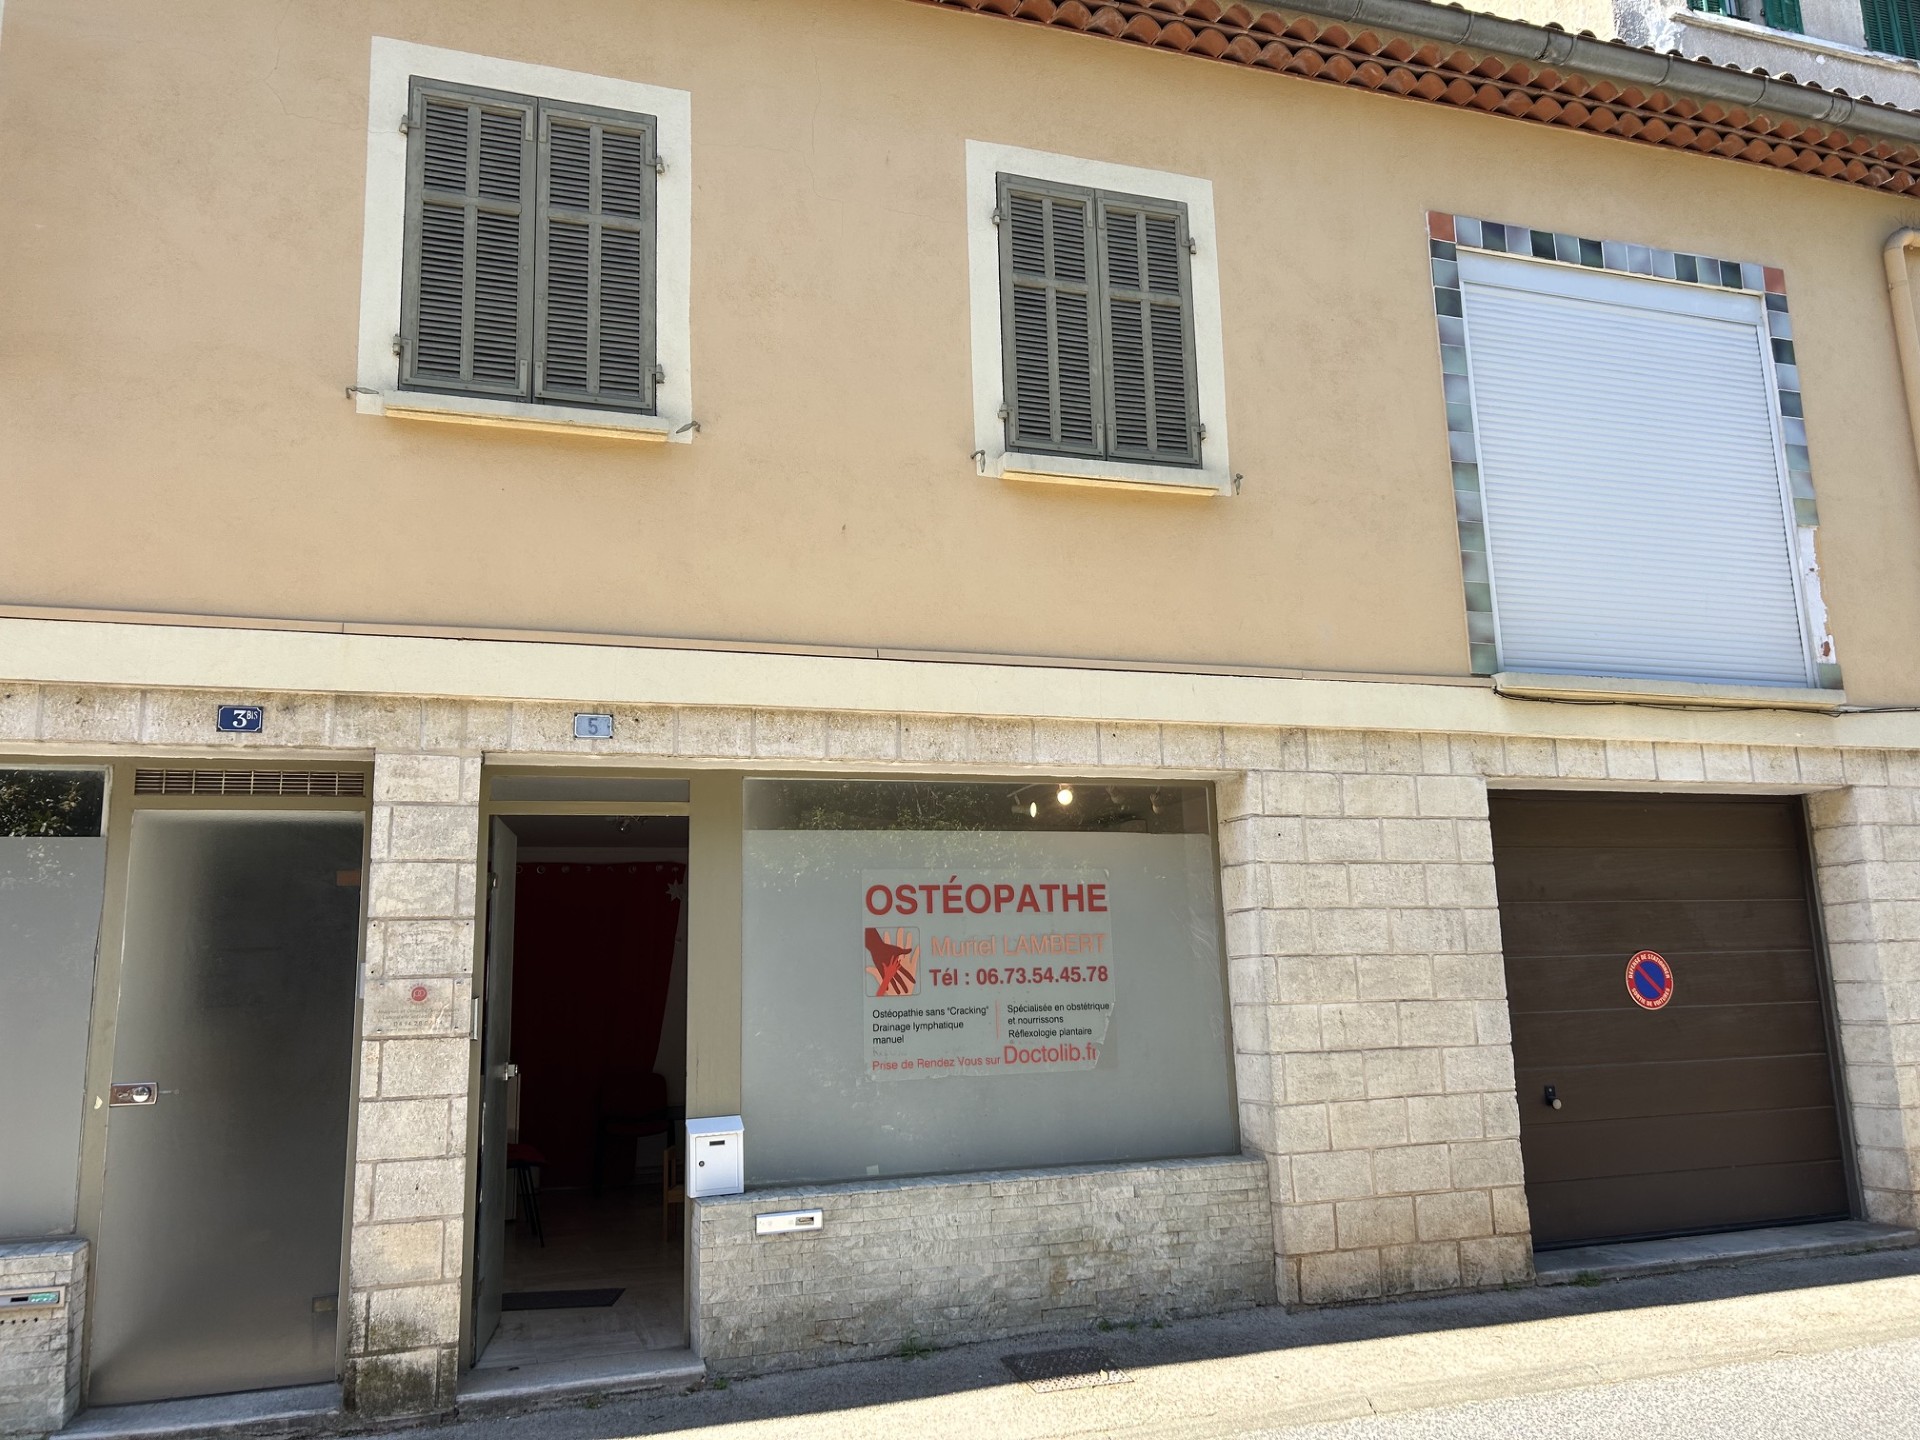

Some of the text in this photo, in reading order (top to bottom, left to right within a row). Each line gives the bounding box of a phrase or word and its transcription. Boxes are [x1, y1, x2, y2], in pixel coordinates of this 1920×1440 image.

[588, 717, 598, 735] 5
[865, 875, 1109, 916] OSTÉOPATHE
[930, 932, 1107, 957] Muriel LAMBERT
[928, 968, 958, 987] Tél
[976, 965, 1109, 986] 06.73.54.45.78
[872, 1008, 924, 1019] Ostéopathie
[925, 1008, 945, 1017] sans
[1007, 1003, 1052, 1015] Spécialisée
[1066, 1002, 1110, 1012] obstétrique
[1007, 1015, 1064, 1025] et nourrissons
[872, 1021, 964, 1033] Drainage lymphatique
[1008, 1027, 1092, 1039] Réflexologie plantaire
[872, 1035, 905, 1044] manuel
[872, 1060, 898, 1071] Prise
[901, 1059, 914, 1069] de
[917, 1057, 955, 1068] Rendez
[957, 1056, 983, 1066] Vous
[985, 1056, 1000, 1065] sur
